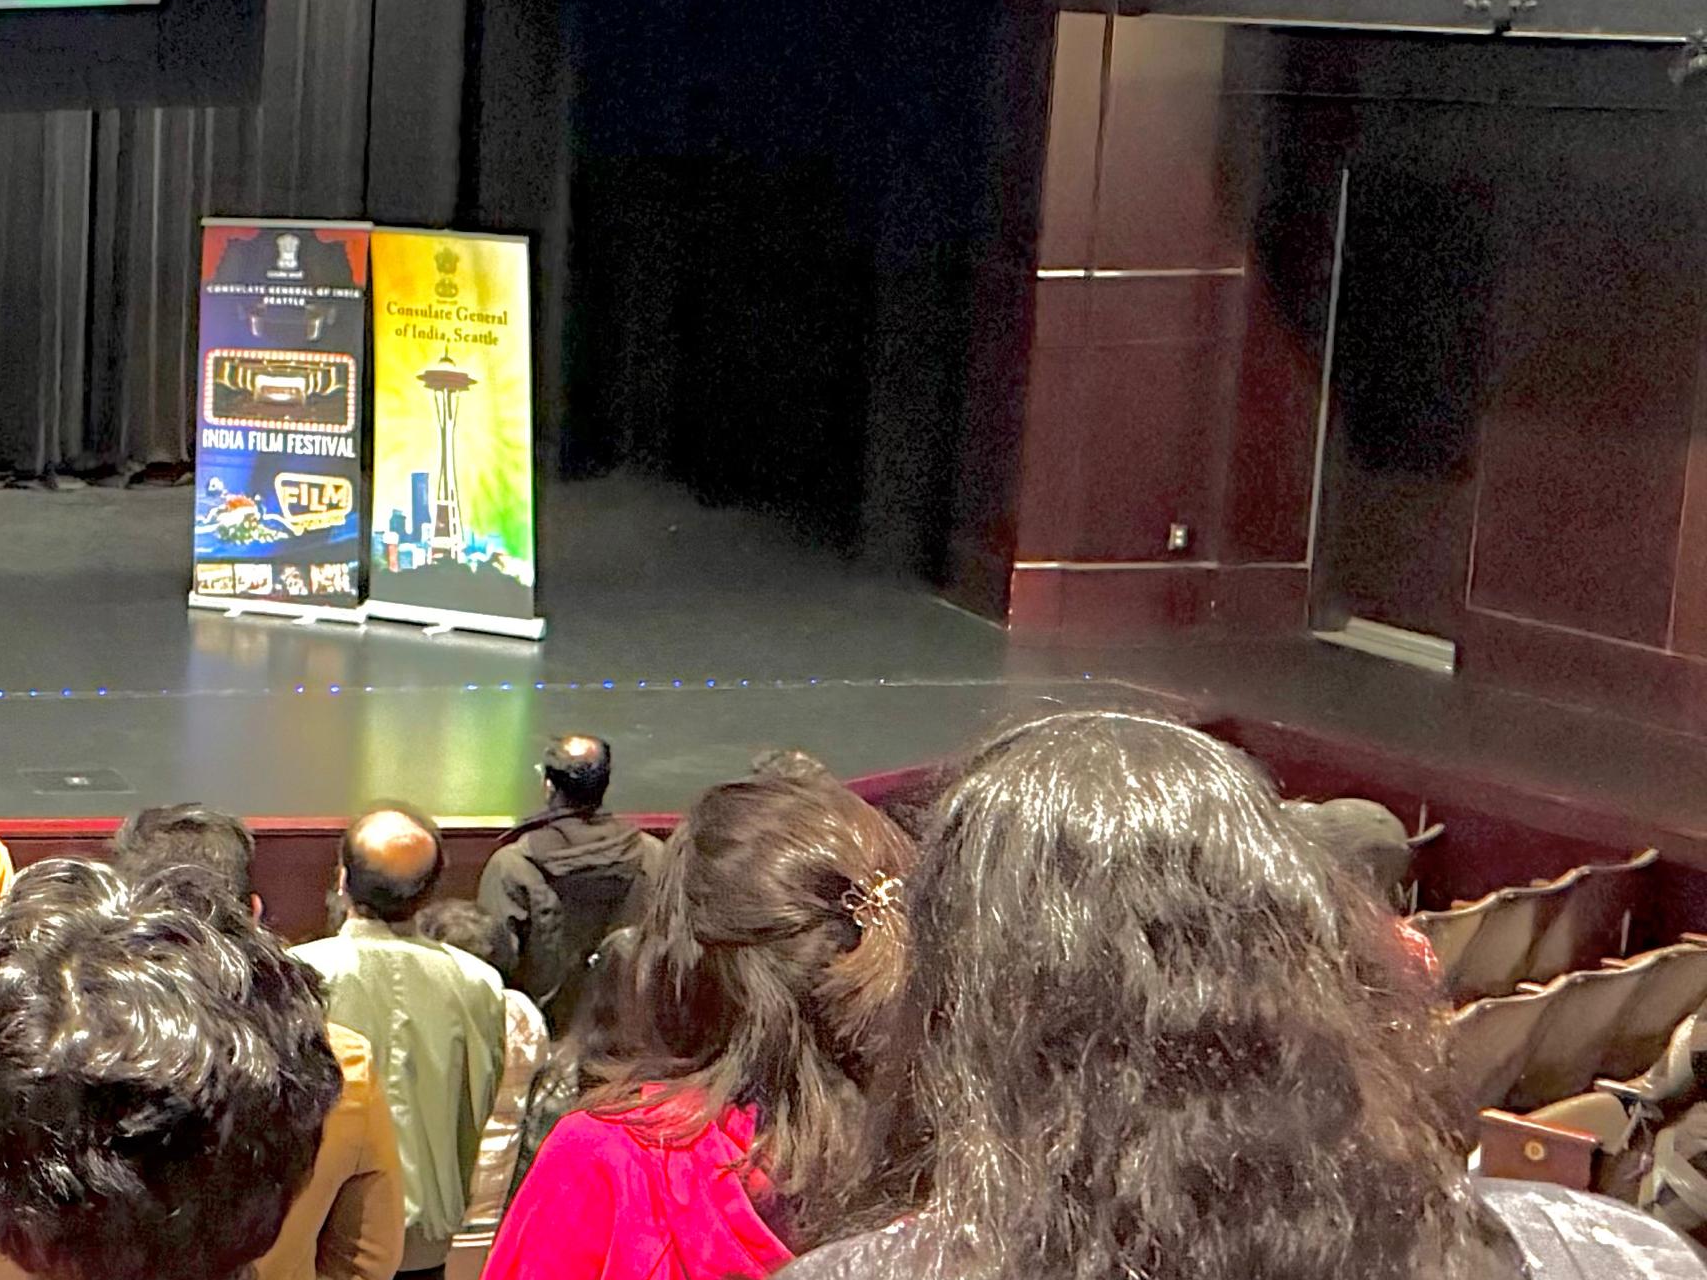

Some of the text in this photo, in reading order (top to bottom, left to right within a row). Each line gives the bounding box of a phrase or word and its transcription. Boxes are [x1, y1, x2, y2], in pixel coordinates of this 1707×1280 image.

[386, 301, 508, 325] Consulate General
[395, 323, 499, 346] of India, Seattle
[202, 429, 356, 458] INDIA FILM FESTIVAL
